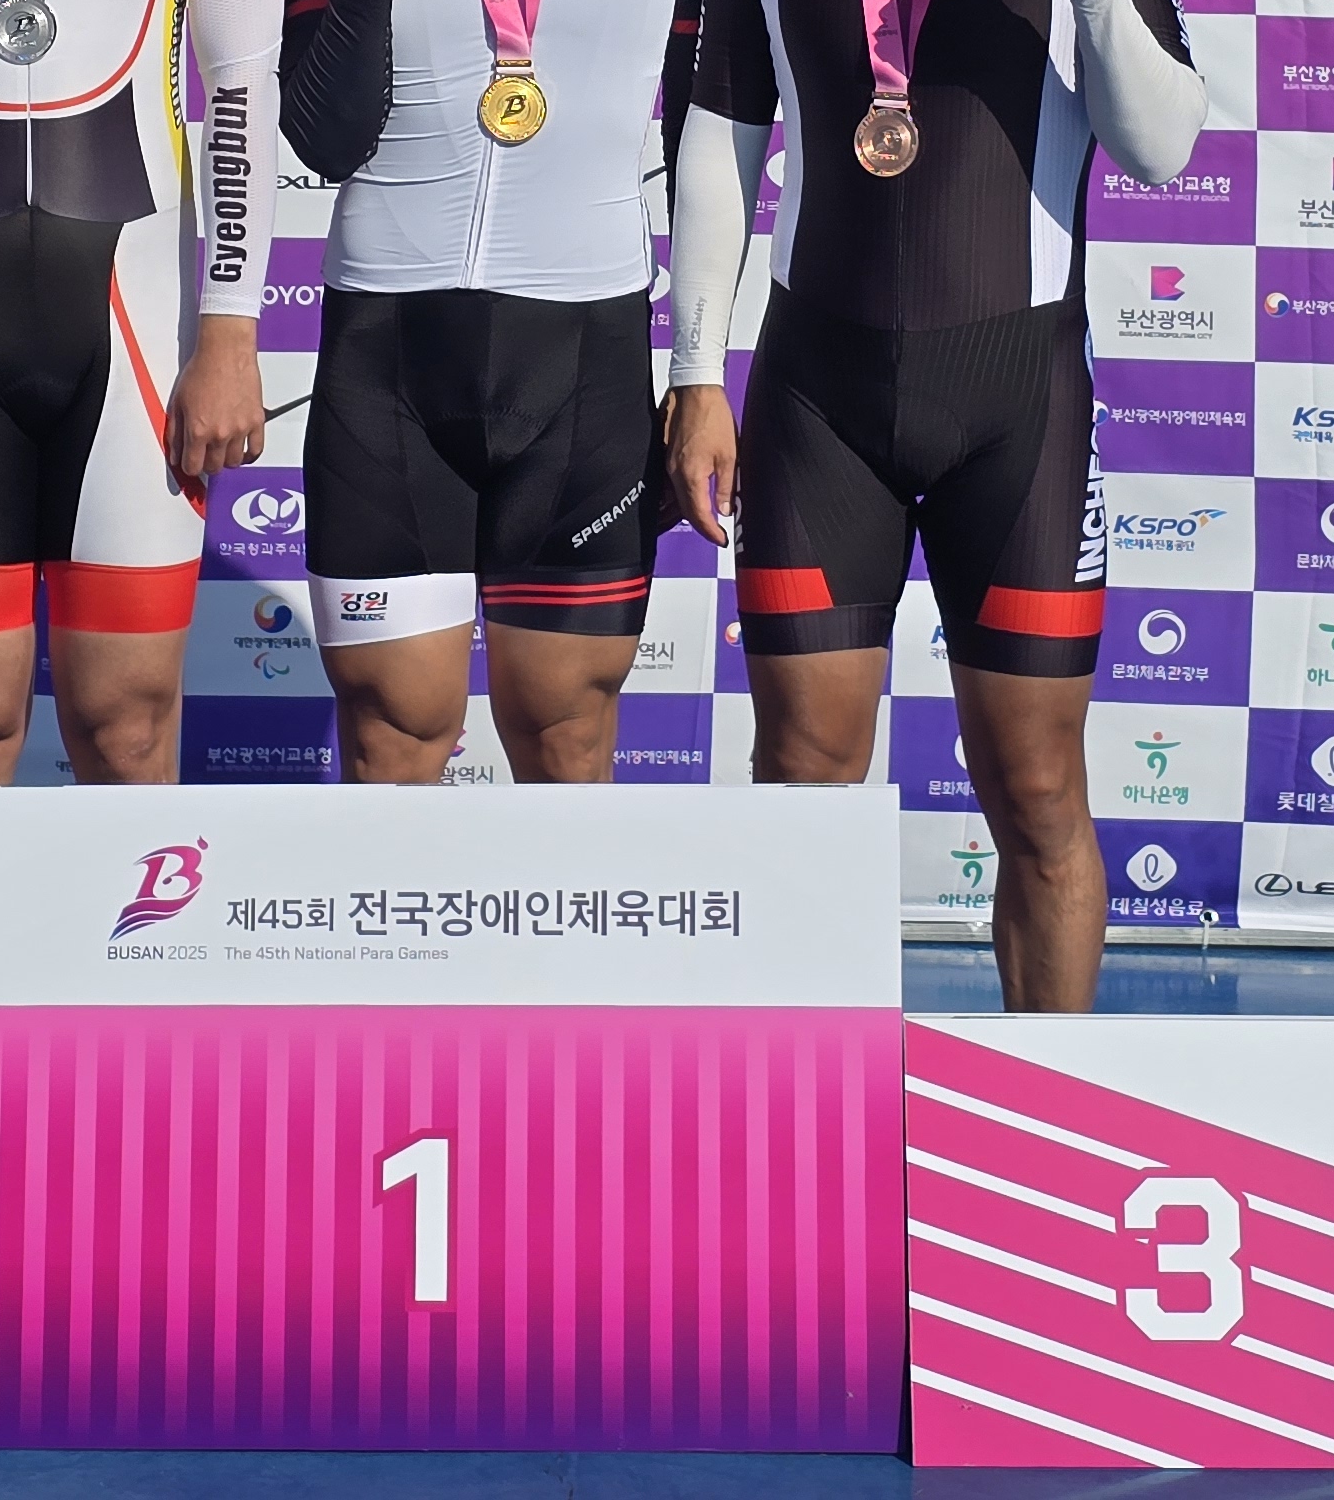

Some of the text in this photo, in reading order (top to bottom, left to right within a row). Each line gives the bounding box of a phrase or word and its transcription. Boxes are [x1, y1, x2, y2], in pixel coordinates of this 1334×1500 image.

[208, 86, 249, 284] Gyeongbuk
[1103, 174, 1231, 194] 부산시교육청
[262, 284, 323, 306] OYOT
[1117, 308, 1214, 331] 부산광역시
[1110, 406, 1247, 426] 부산광역시장애인체육회
[1113, 514, 1198, 537] KSPO
[219, 541, 306, 558] 한국청과주식
[340, 590, 388, 613] 강원
[1111, 663, 1210, 684] 문화체육관광부
[206, 745, 333, 765] 부산광역시교육청
[613, 750, 704, 765] 시장애인체육회
[1122, 784, 1190, 806] 하나은행
[225, 889, 743, 940] 제45회 전국장애인체육대회
[107, 945, 449, 961] BUSAN 2025 The 45th National Para Games
[383, 1138, 449, 1302] 1
[1123, 1177, 1244, 1342] 3
